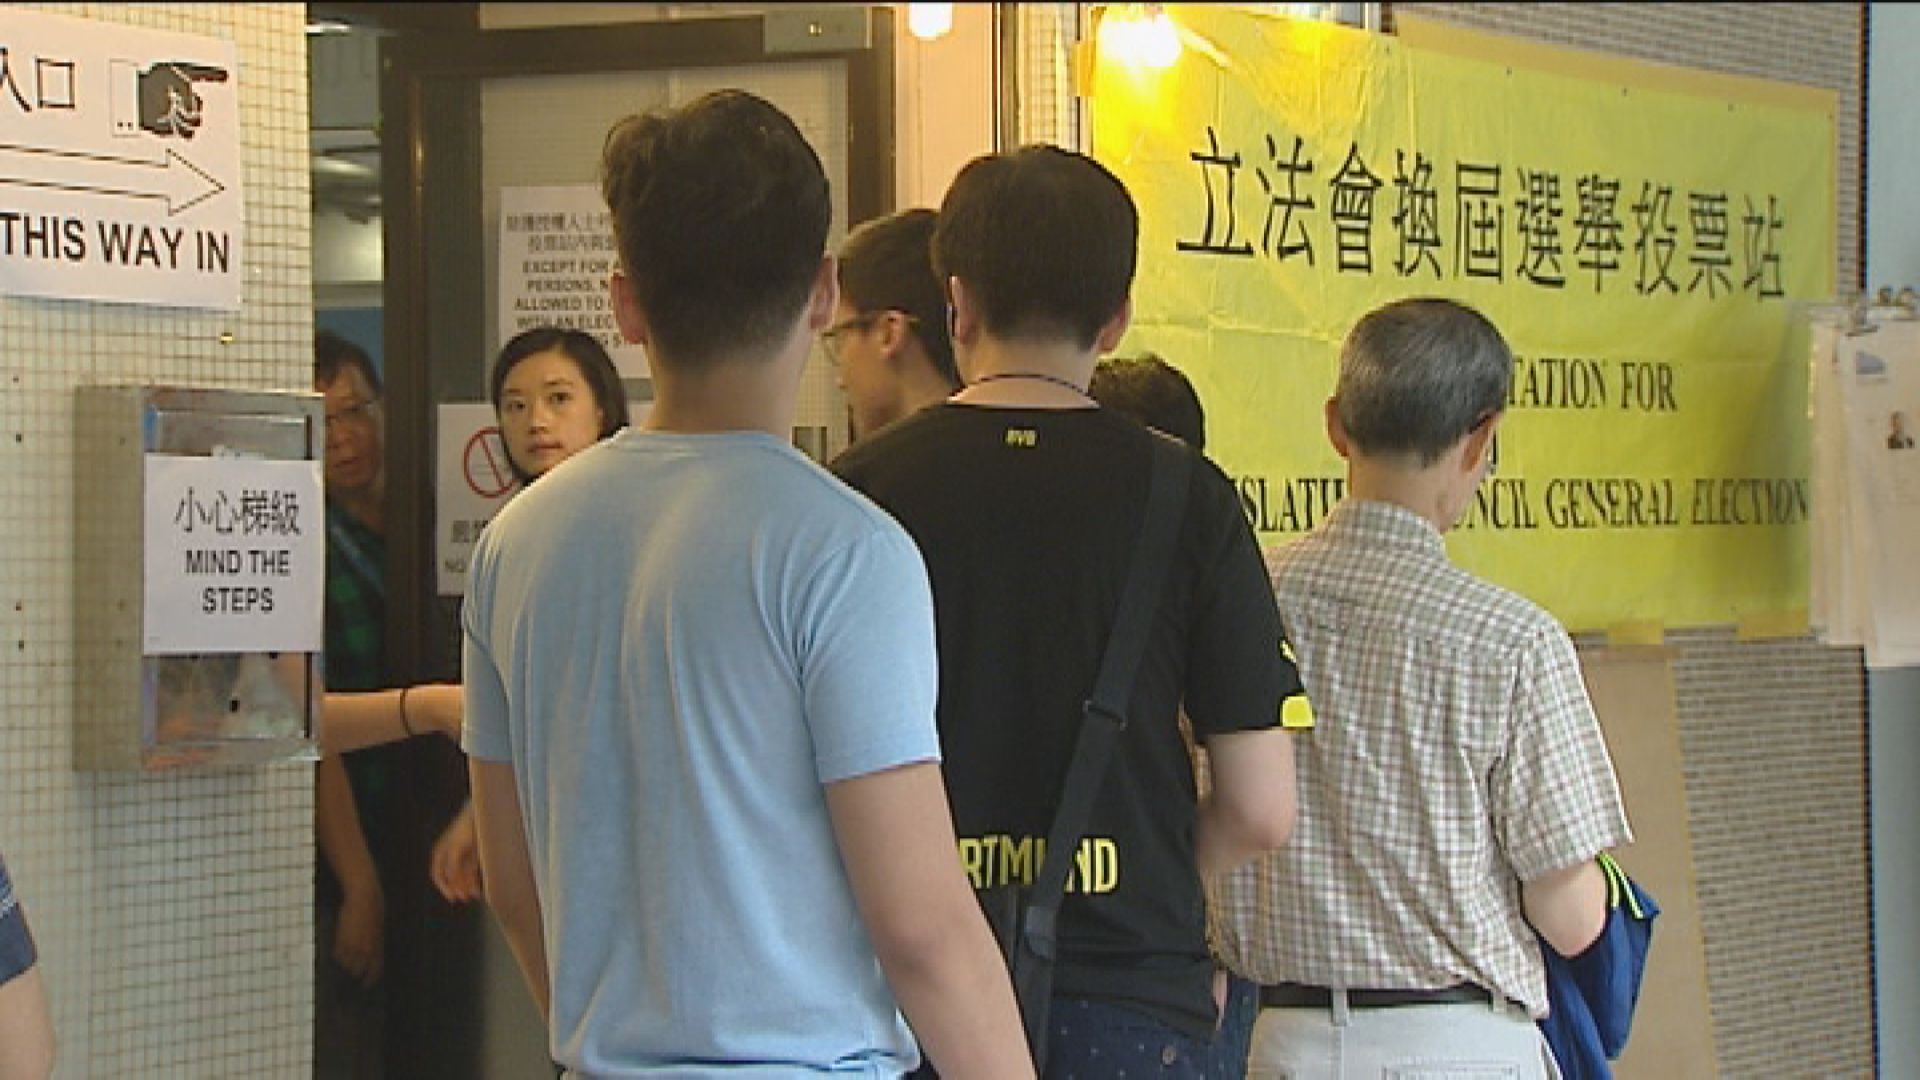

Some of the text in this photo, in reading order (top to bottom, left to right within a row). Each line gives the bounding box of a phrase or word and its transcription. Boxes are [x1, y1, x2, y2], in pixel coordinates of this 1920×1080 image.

[1176, 126, 1785, 299] 立法會換屆選舉投票站
[0, 212, 229, 273] THIS WAY IN
[523, 260, 575, 273] EXCEPT
[580, 260, 608, 273] FOR
[515, 297, 582, 311] ALLOWED
[586, 297, 602, 311] TO
[578, 315, 612, 329] ELEC
[1508, 358, 1678, 412] TATION FOR
[173, 486, 301, 535] 小心梯級
[1545, 476, 1679, 528] GENERAL
[1691, 477, 1808, 526] ELECTION
[184, 549, 291, 575] MIND THE
[202, 586, 274, 614] STEPS
